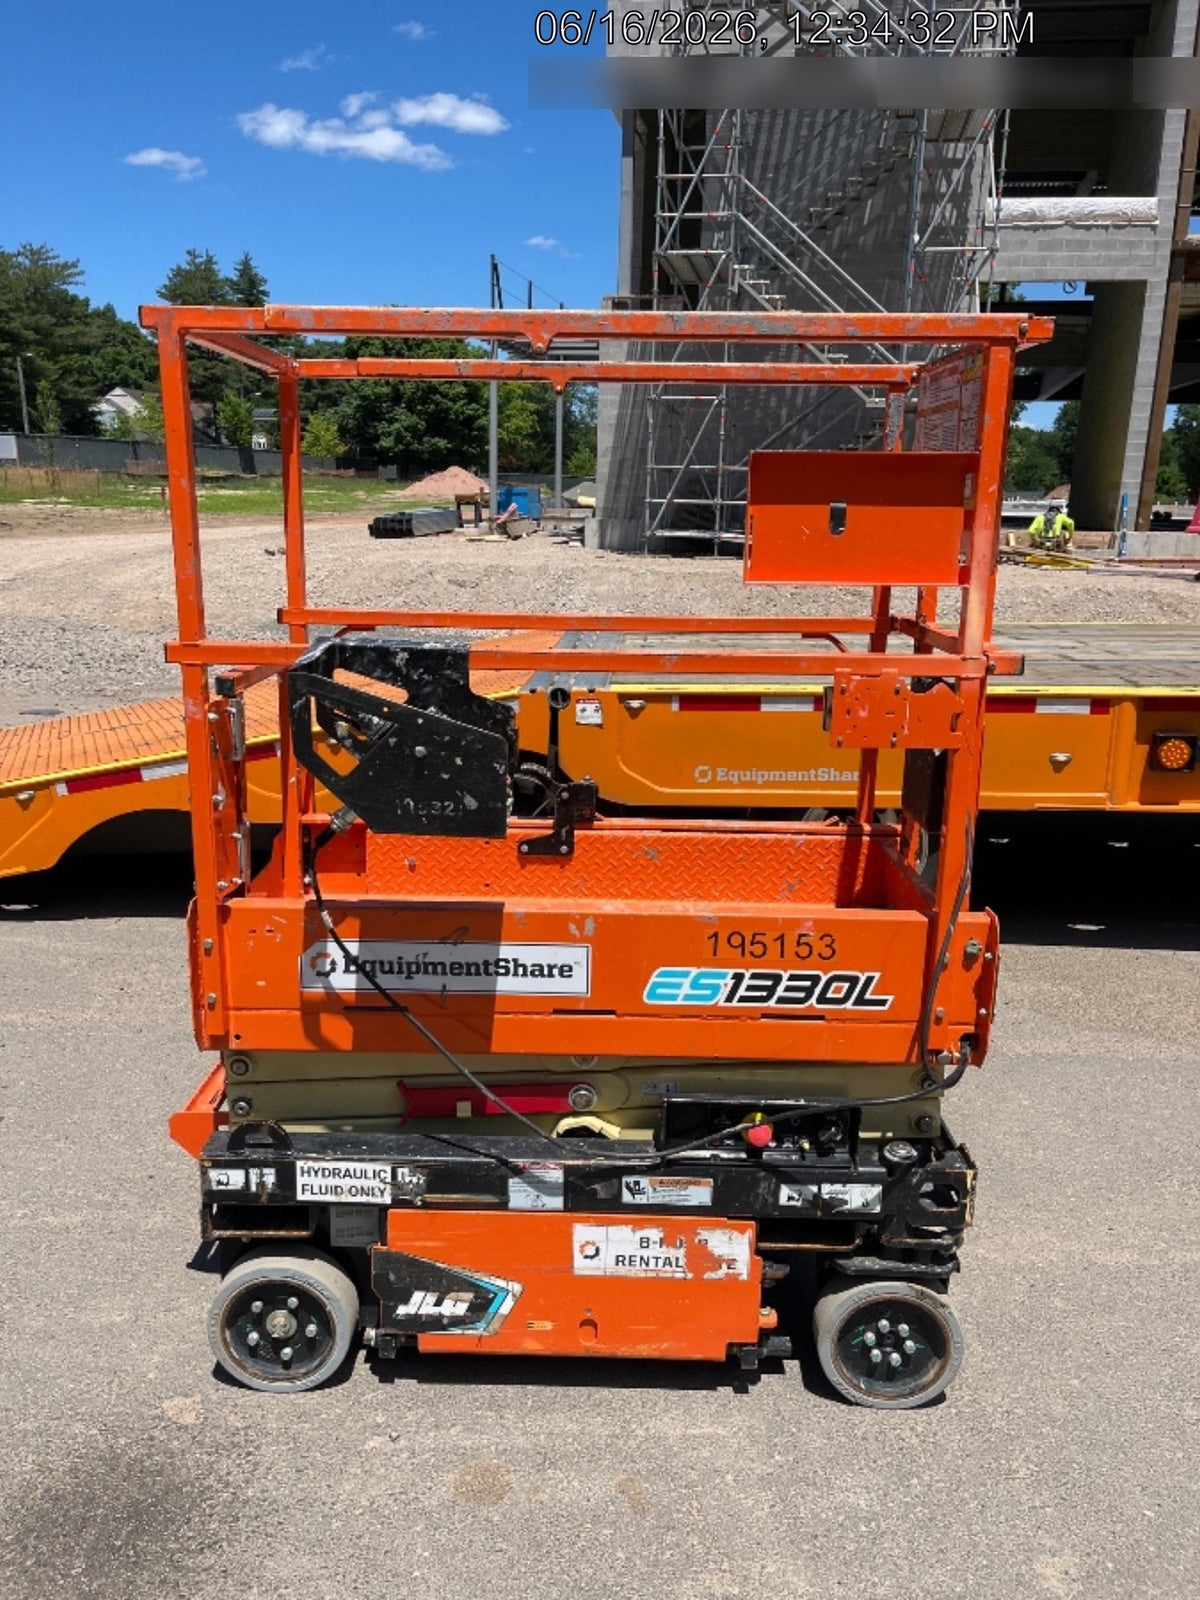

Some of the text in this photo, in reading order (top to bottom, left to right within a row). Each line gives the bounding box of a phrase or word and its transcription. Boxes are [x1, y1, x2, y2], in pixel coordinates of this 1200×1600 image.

[716, 766, 860, 785] EquipmentShar
[706, 930, 837, 961] 195153
[342, 953, 574, 981] EquipmentShare
[644, 967, 893, 1009] ES1330L
[300, 1165, 388, 1182] HYDRAULIC
[301, 1183, 387, 1199] FLUID ONLY
[615, 1254, 685, 1270] RENTAL
[396, 1290, 475, 1316] JLG
